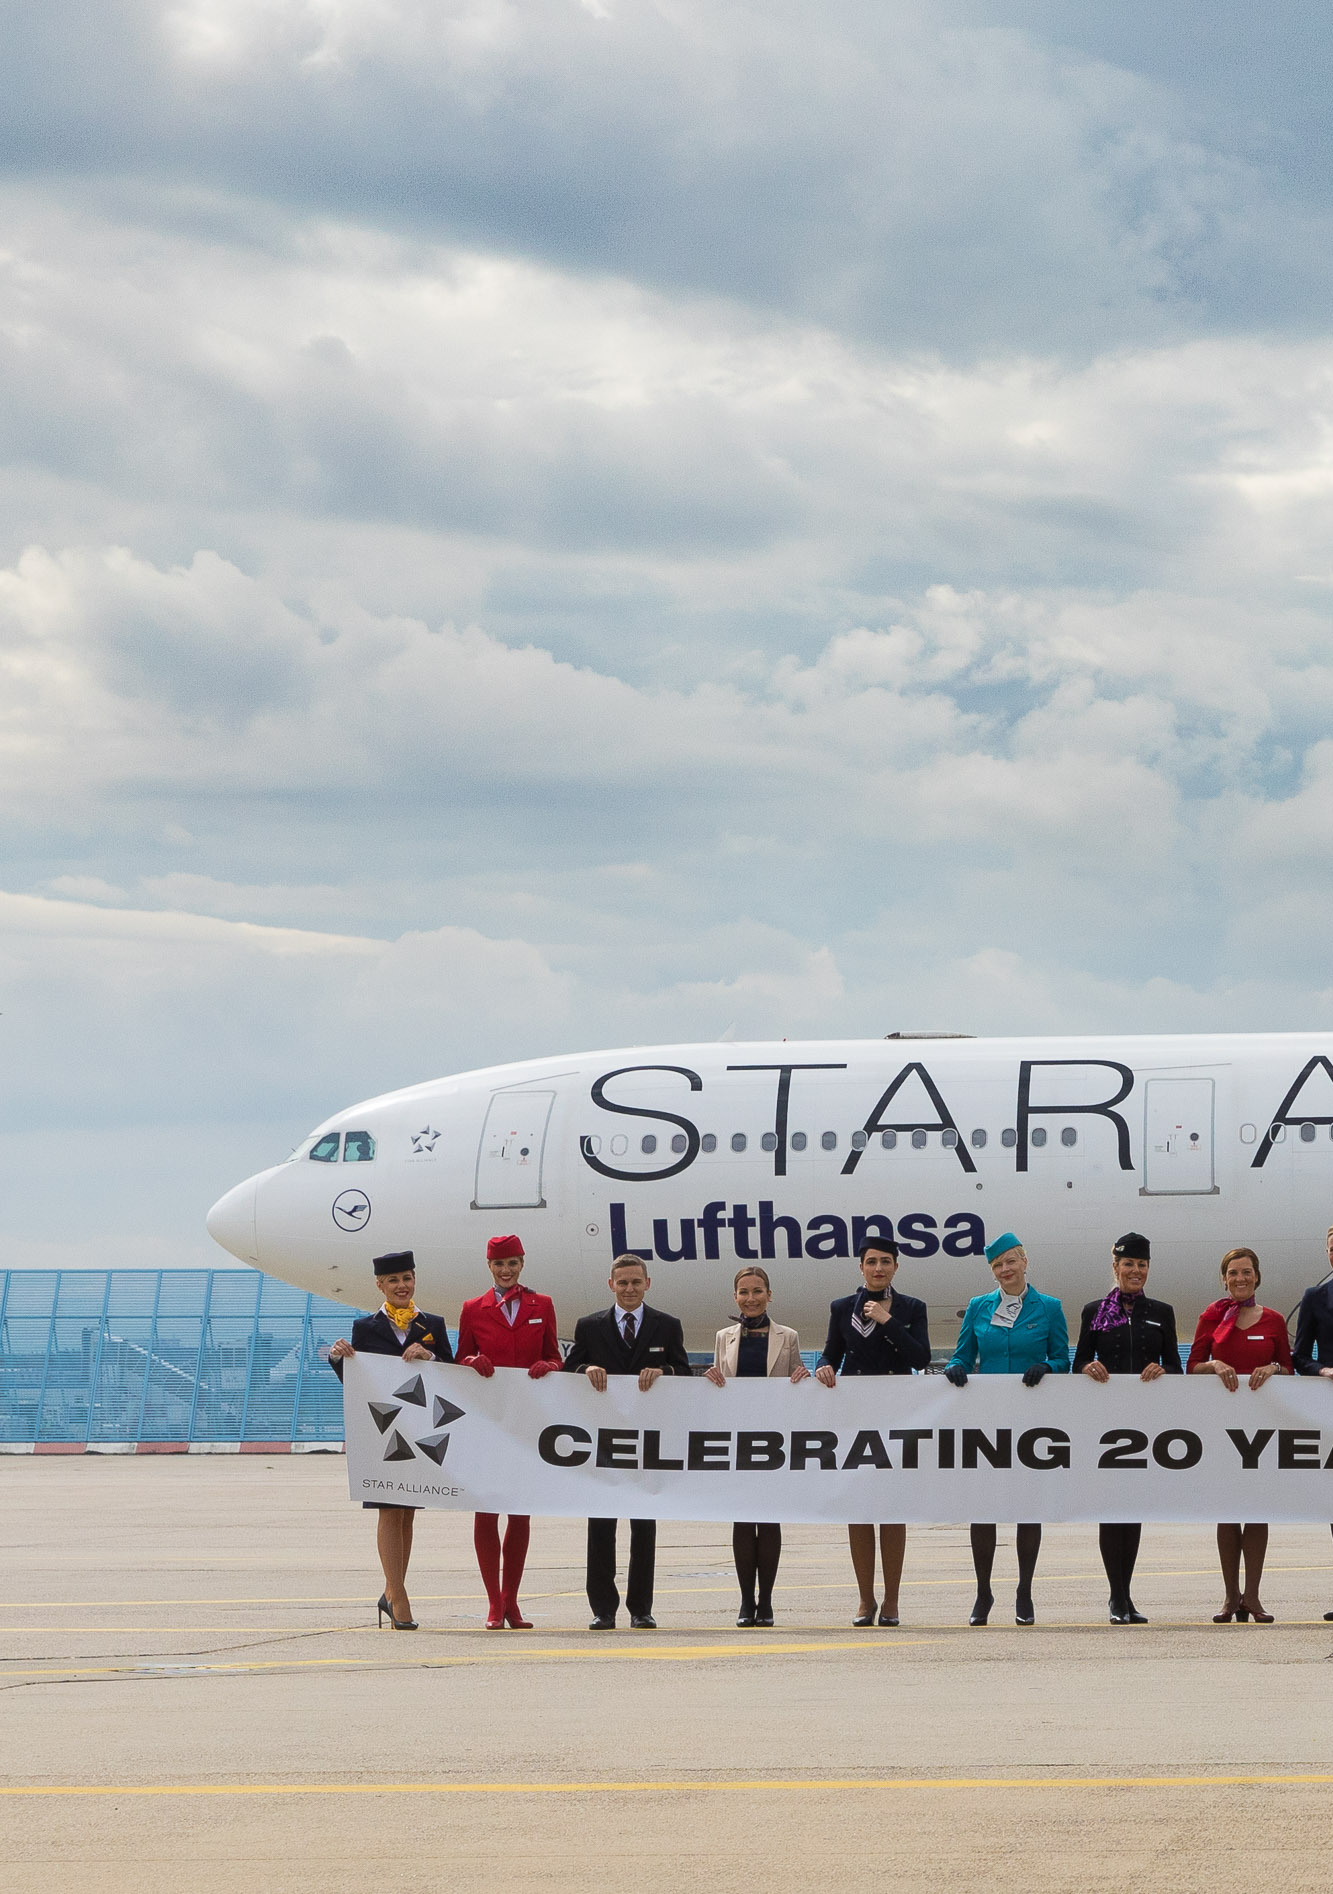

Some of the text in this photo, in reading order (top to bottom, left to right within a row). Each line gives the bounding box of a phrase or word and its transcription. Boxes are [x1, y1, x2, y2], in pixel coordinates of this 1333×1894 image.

[580, 1060, 1135, 1182] STAR
[610, 1201, 986, 1262] Lufthansa
[538, 1424, 1071, 1471] CELEBRATING
[1097, 1428, 1203, 1470] 20
[362, 1478, 394, 1491] STAR
